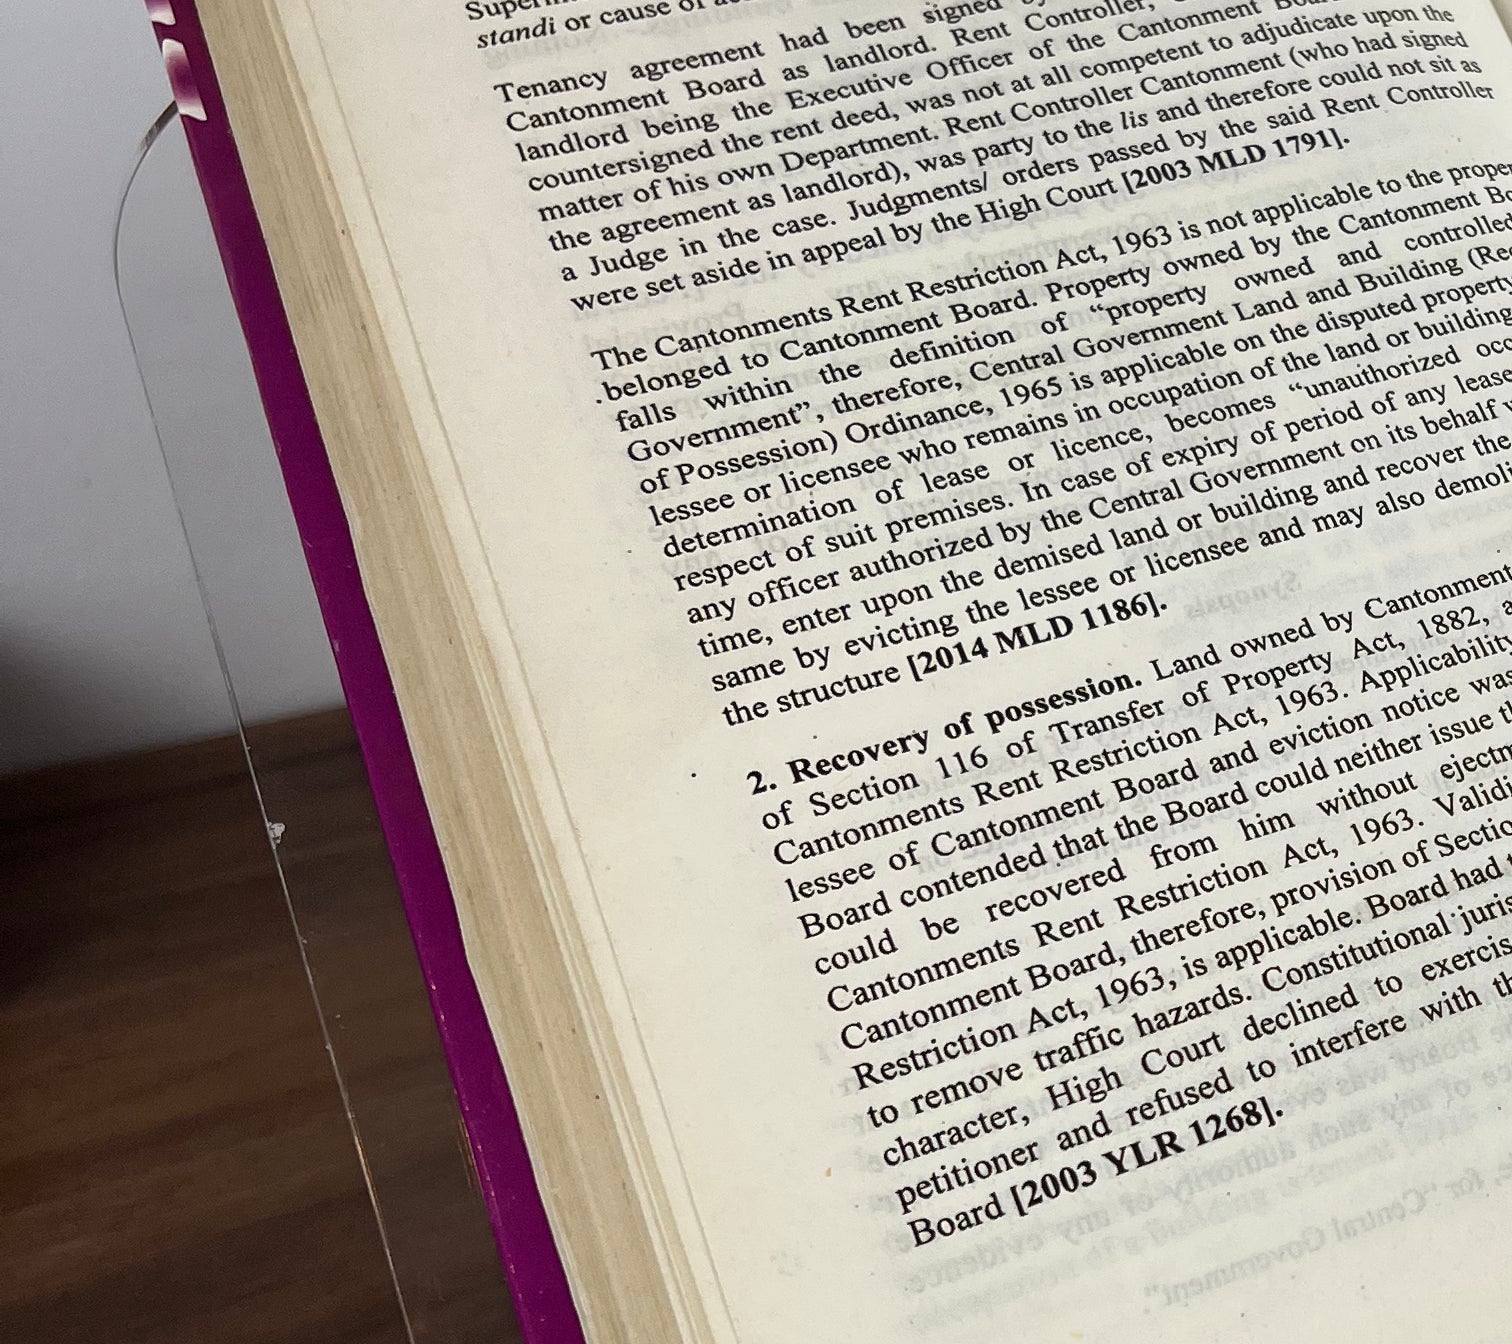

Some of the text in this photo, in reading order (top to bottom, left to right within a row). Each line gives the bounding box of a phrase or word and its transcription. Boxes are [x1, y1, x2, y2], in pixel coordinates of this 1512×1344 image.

[476, 16, 557, 49] standi
[564, 13, 591, 32] or
[599, 1, 672, 25] cause
[569, 127, 1350, 311] were set aside in appeal by the High Court [2003 MLD 1791].
[589, 345, 648, 371] The
[654, 305, 833, 357] Cantonments
[834, 288, 904, 318] Rent
[904, 258, 1049, 303] Restriction
[1056, 243, 1108, 270] Act,
[1111, 224, 1172, 256] 1963
[1176, 219, 1202, 241] is
[1204, 209, 1248, 235] not
[1251, 181, 1373, 227] applicable
[1375, 178, 1402, 195] to
[1404, 168, 1444, 189] the
[745, 770, 777, 796] 2.
[784, 729, 929, 784] Recovery
[943, 710, 975, 740] of
[983, 673, 1142, 735] possession.
[1148, 642, 1223, 682] Land
[1229, 616, 1317, 659] owned
[1318, 610, 1353, 634] by
[894, 1141, 1039, 1215] petitioner
[1056, 1109, 1113, 1151] and
[1125, 1066, 1235, 1126] refused
[1244, 1059, 1277, 1083] to
[1288, 1014, 1407, 1068] interfere
[1418, 984, 1483, 1022] with
[906, 1095, 1284, 1248] Board [2003 YLR 1268].
